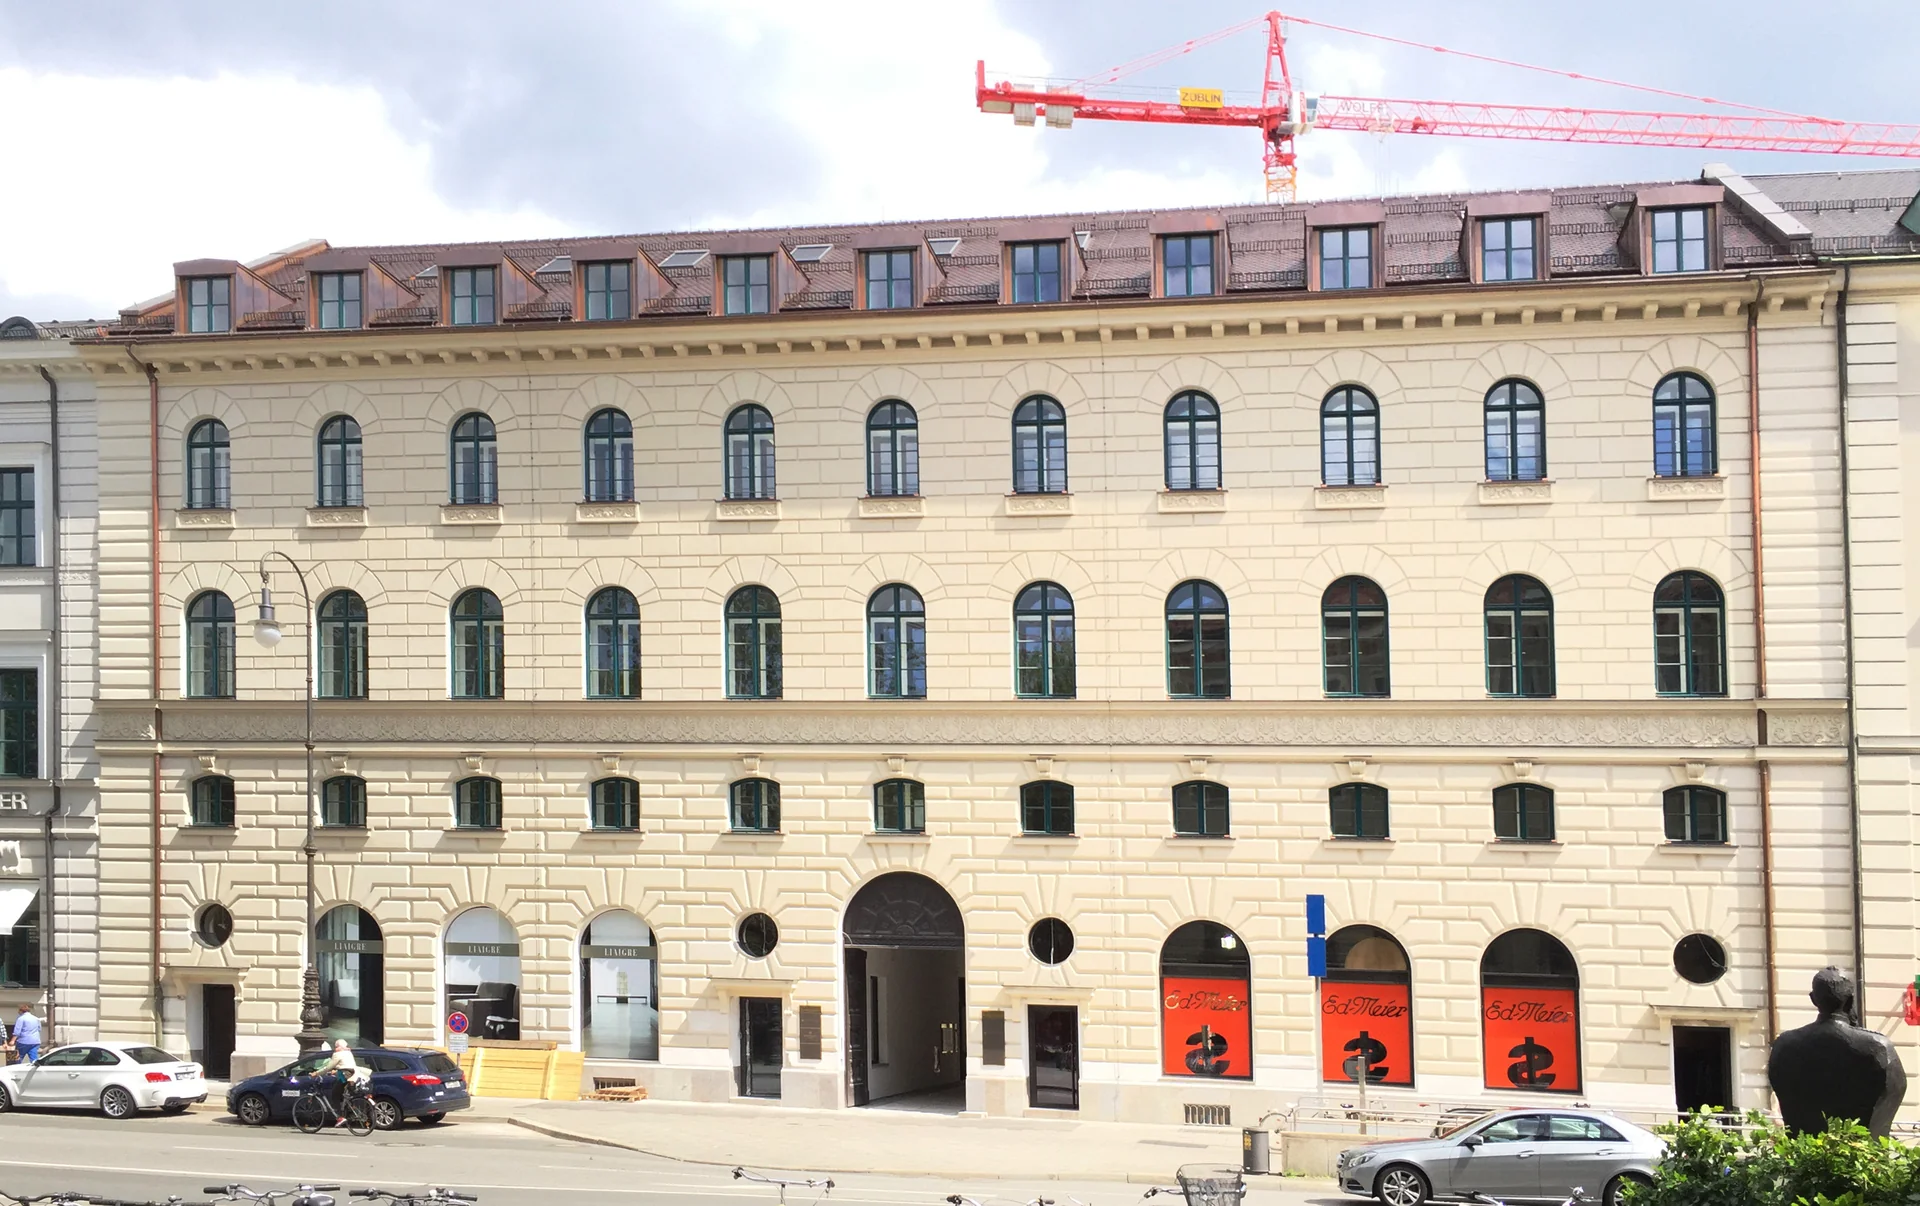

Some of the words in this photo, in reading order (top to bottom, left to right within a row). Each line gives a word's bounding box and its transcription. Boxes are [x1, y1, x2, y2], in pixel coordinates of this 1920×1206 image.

[0, 792, 28, 810] ER
[334, 942, 367, 951] LIAIGRE
[468, 945, 501, 954] LIAIGRE
[604, 948, 638, 957] LIAIGRE
